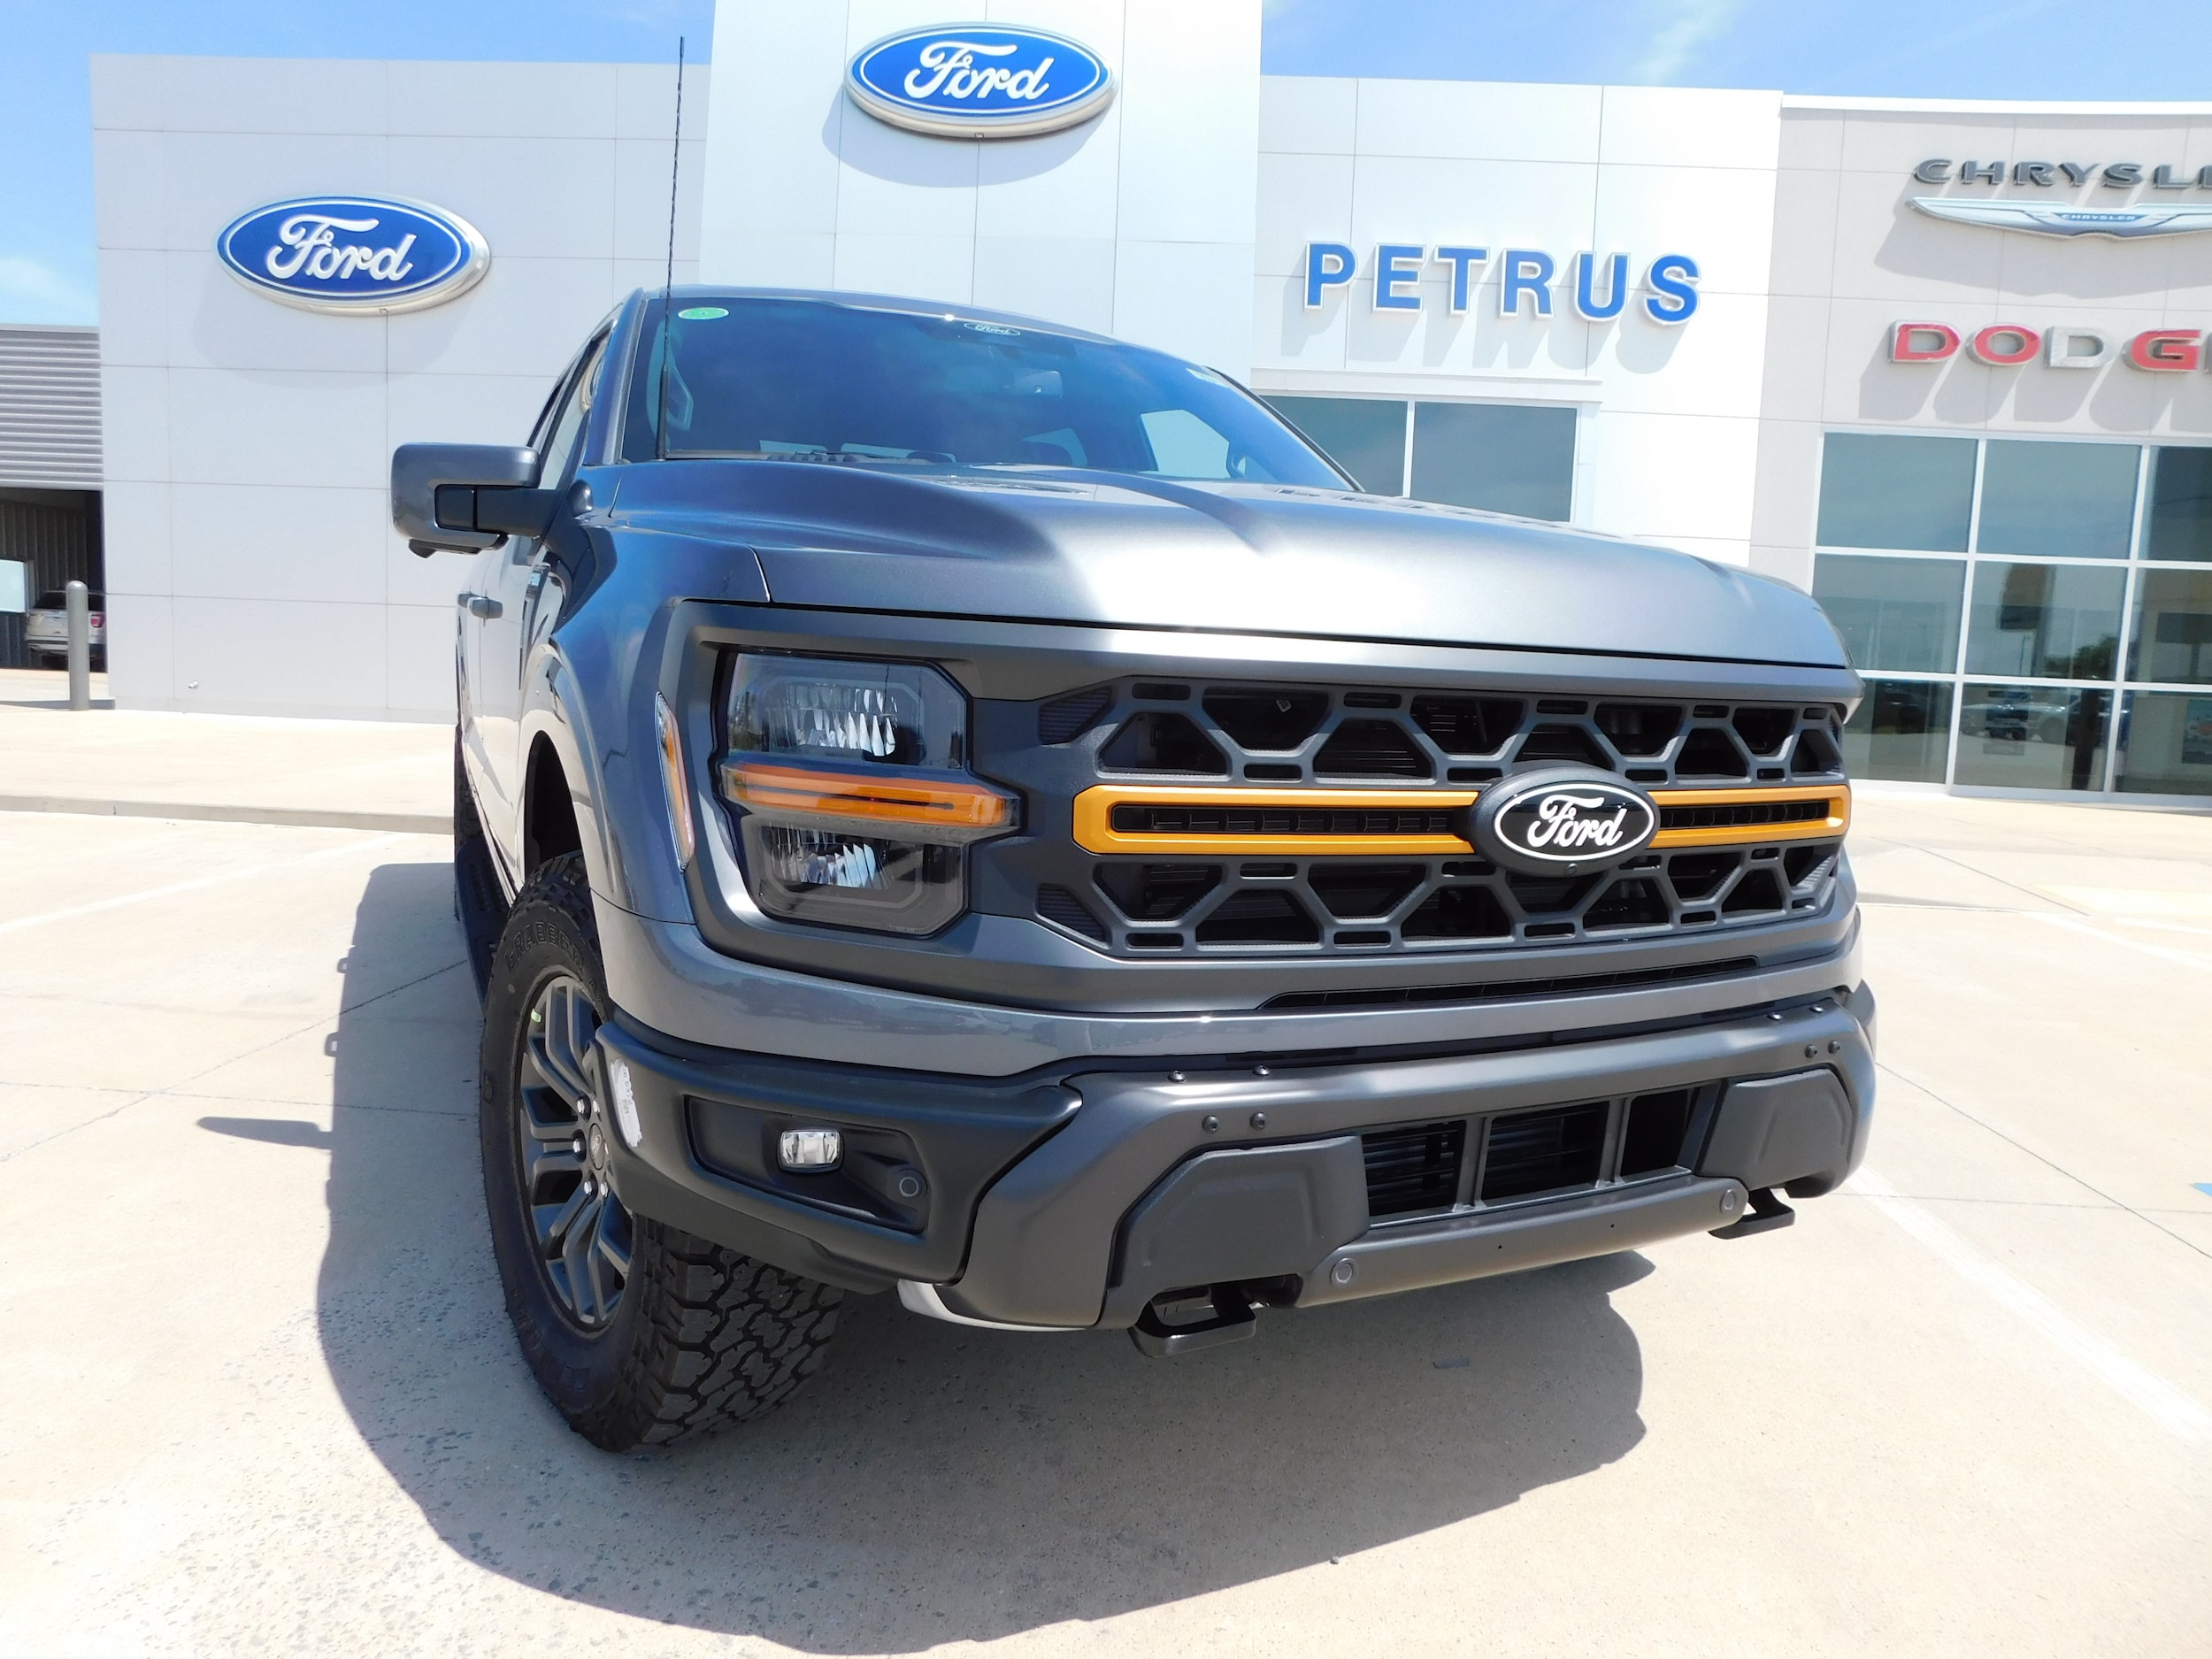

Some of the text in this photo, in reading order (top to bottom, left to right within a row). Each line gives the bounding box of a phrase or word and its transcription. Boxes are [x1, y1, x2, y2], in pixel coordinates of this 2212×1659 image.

[903, 42, 1055, 100] Ford
[266, 214, 417, 280] Ford
[1304, 241, 1701, 325] PETRUS
[1888, 319, 2212, 374] DODG
[1526, 794, 1628, 848] Ford
[504, 921, 584, 974] GRABBER
